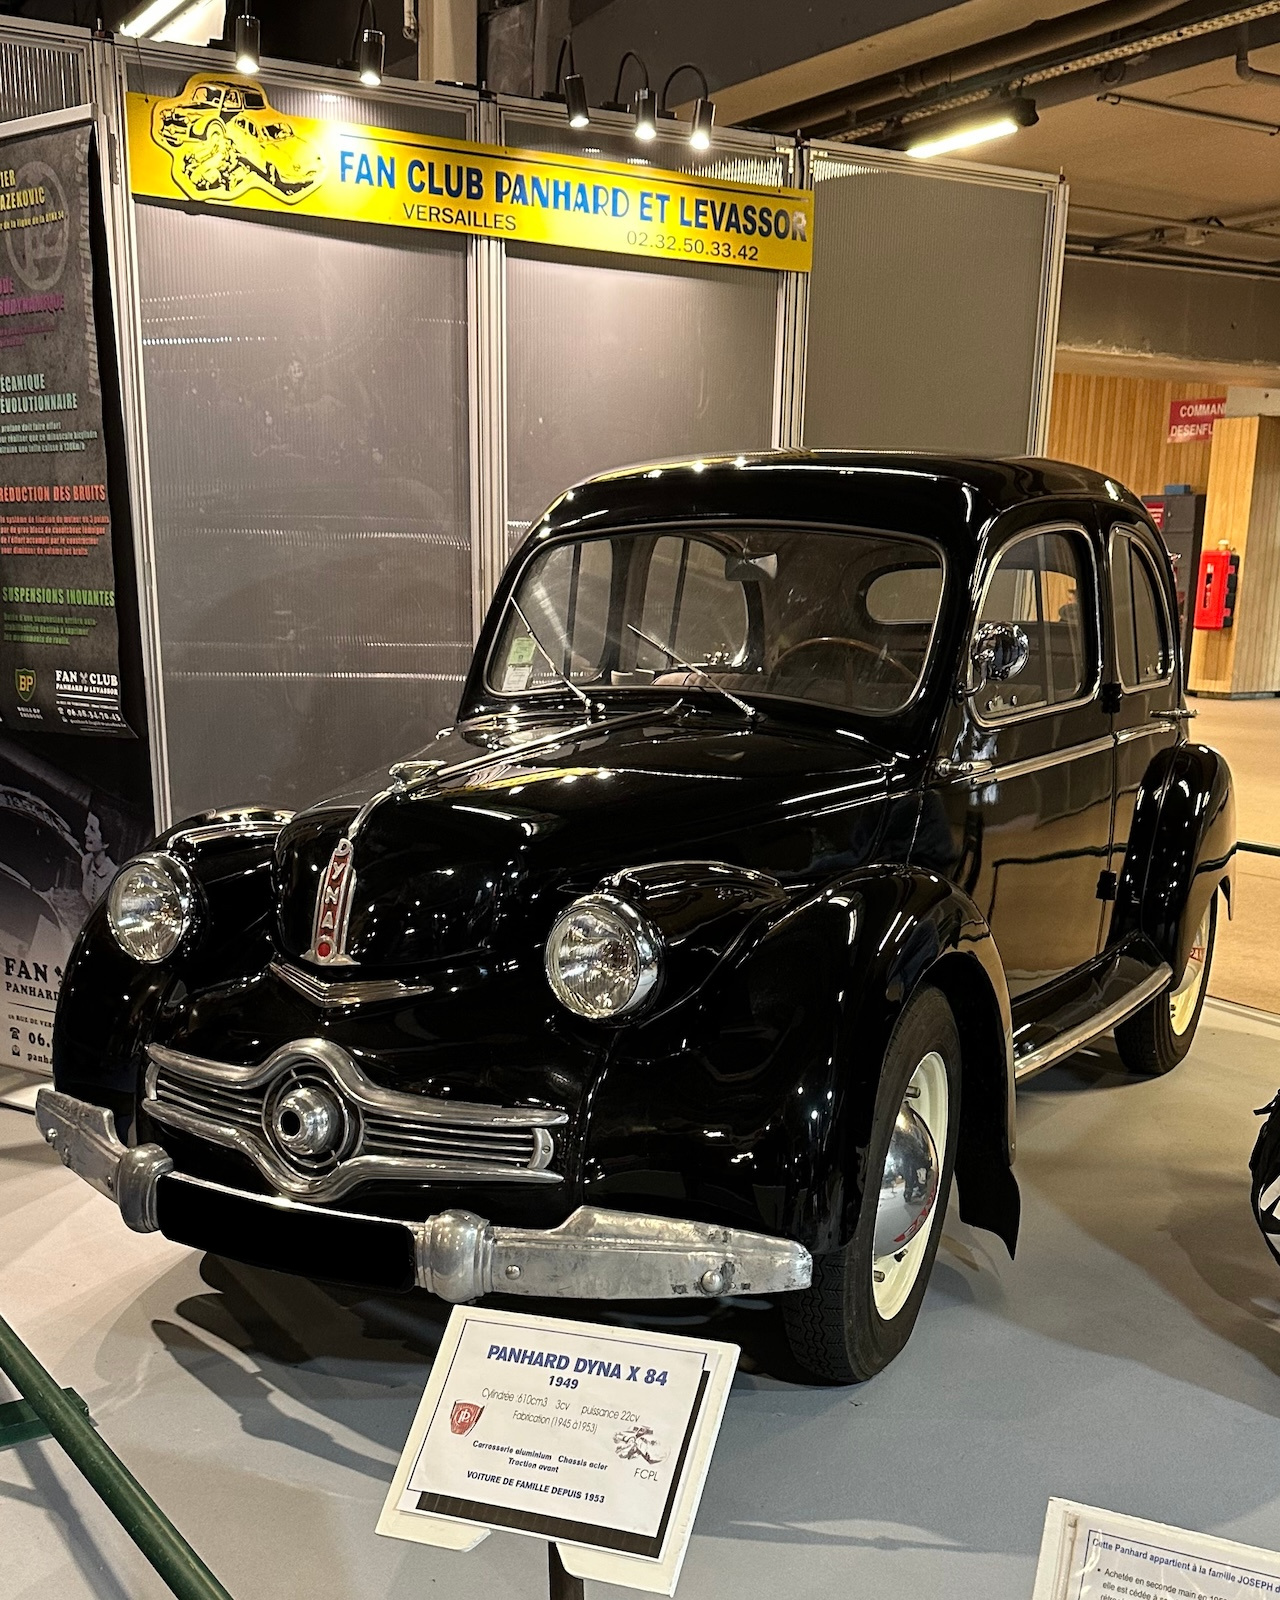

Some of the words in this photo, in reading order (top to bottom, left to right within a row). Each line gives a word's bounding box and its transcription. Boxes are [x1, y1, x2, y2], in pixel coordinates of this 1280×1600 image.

[0, 169, 16, 187] IER
[340, 151, 395, 189] FAN
[408, 159, 483, 200] CLUB
[495, 171, 629, 217] PANHARD
[640, 191, 670, 223] ET
[679, 197, 807, 242] LEVASSOR
[403, 203, 516, 231] VERSAILLES
[627, 230, 758, 261] 02.32.50.33.42
[0, 393, 78, 414] ÉVOLUTIONNAIRE
[1180, 402, 1226, 418] COMMAN
[0, 485, 50, 502] RÉDUCTION
[53, 486, 71, 501] DES
[73, 485, 106, 501] BRUITS
[2, 586, 65, 605] SUSPENSIONS
[66, 589, 116, 607] INOVANTES
[19, 674, 34, 691] BP
[55, 670, 78, 683] FAN
[89, 673, 118, 686] CLUB
[56, 683, 83, 692] PANHARD
[89, 686, 118, 695] LEVASSOR
[321, 837, 352, 930] DYNA
[4, 956, 48, 983] FAN
[29, 1032, 53, 1047] 06.
[487, 1344, 570, 1371] PANHARD
[573, 1357, 622, 1380] DYNA
[625, 1365, 641, 1382] X
[644, 1368, 669, 1387] 84
[548, 1375, 579, 1390] 1949
[481, 1387, 515, 1404] Cylindrée
[555, 1399, 570, 1411] 3cv
[581, 1404, 620, 1420] puissance
[620, 1410, 641, 1423] 22cv
[512, 1410, 551, 1425] Fabrication
[551, 1413, 572, 1428] (1945
[472, 1439, 514, 1455] Carrosserie
[515, 1447, 552, 1461] aluminium
[557, 1454, 587, 1468] Chassis
[588, 1459, 608, 1471] acier
[508, 1457, 537, 1469] Traction
[538, 1463, 559, 1473] avant
[633, 1467, 659, 1482] FCPL
[466, 1470, 501, 1484] VOITURE
[502, 1476, 515, 1487] DE
[515, 1479, 550, 1493] FAMILLE
[551, 1486, 582, 1500] DEPUIS
[584, 1491, 605, 1504] 1953
[1115, 1543, 1148, 1560] Panhard
[1149, 1554, 1190, 1571] appartient
[1191, 1563, 1197, 1572] à
[1198, 1566, 1207, 1575] la
[1208, 1568, 1236, 1582] famille
[1237, 1575, 1274, 1592] JOSEPH
[1102, 1582, 1116, 1591] elle
[1116, 1586, 1128, 1594] est
[1104, 1568, 1134, 1583] Achetée
[1135, 1578, 1145, 1586] en
[1146, 1580, 1177, 1594] seconde
[1177, 1588, 1196, 1600] main
